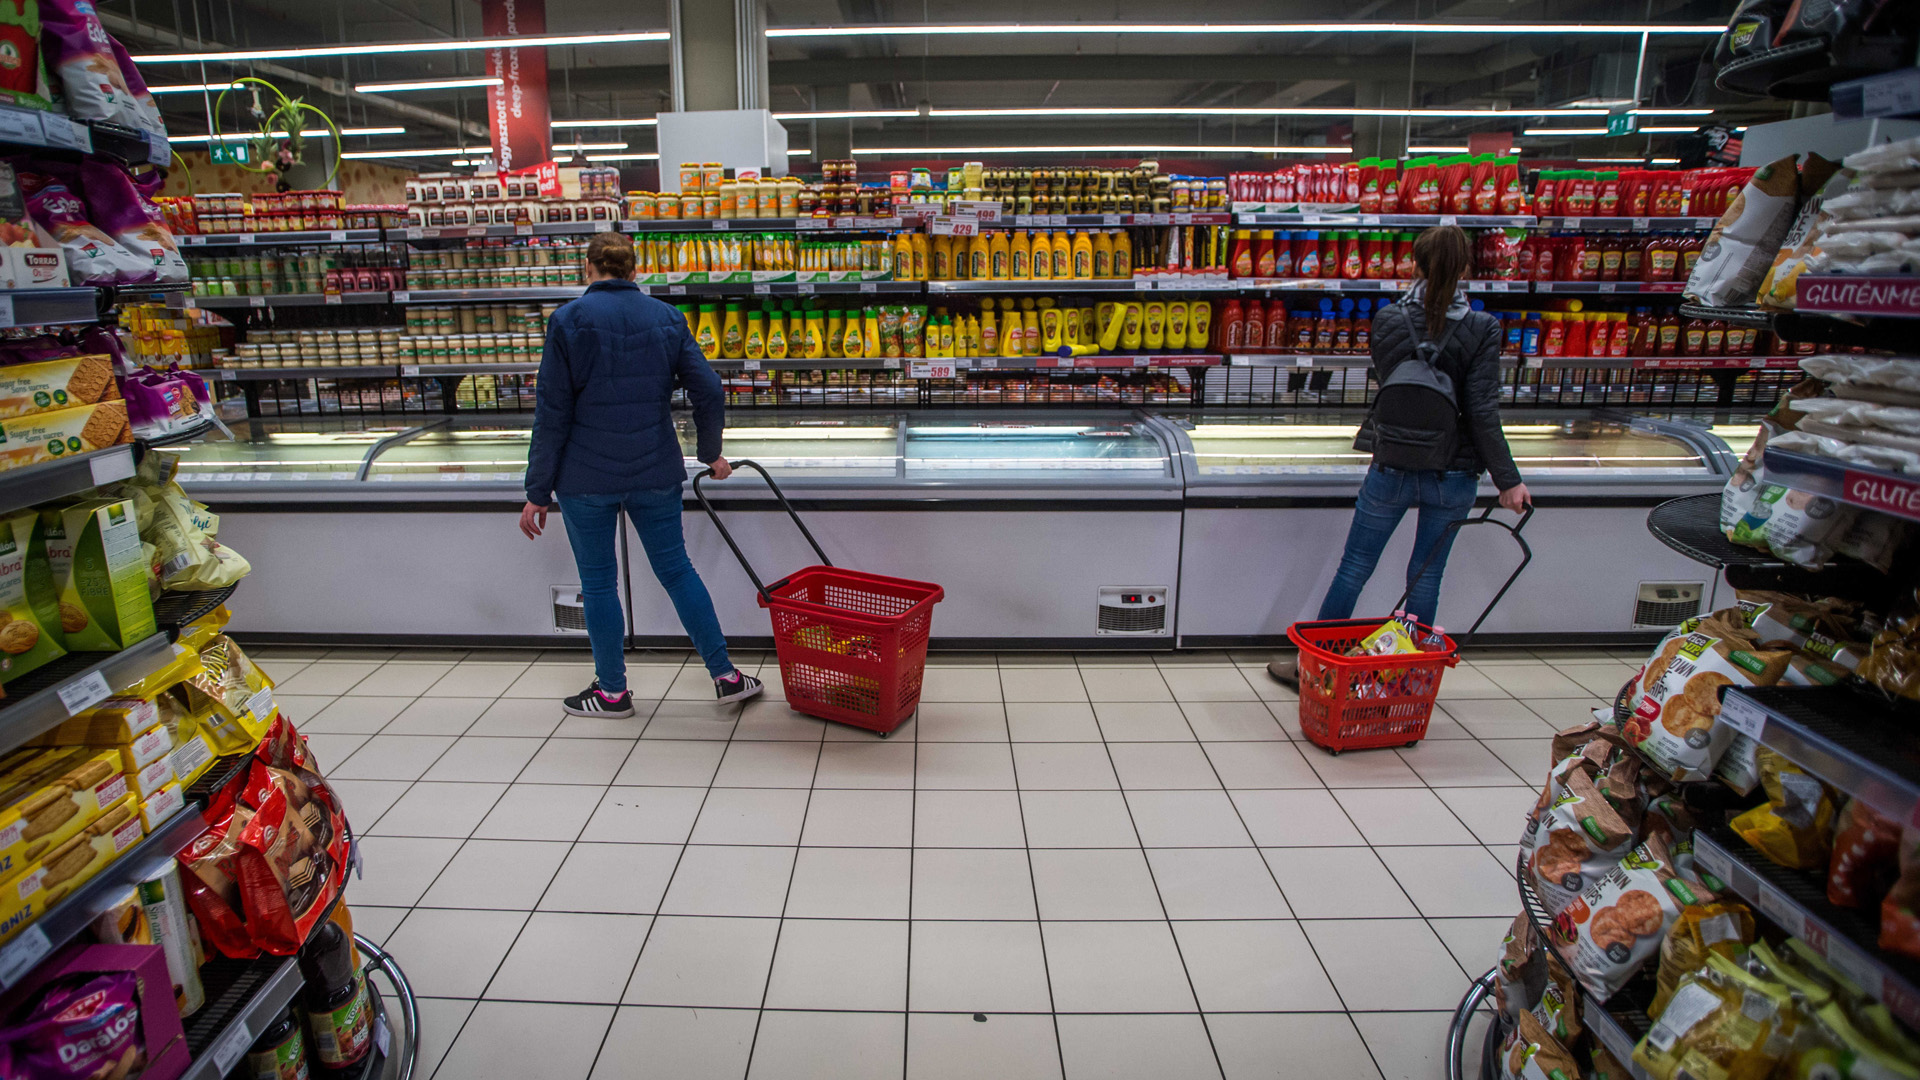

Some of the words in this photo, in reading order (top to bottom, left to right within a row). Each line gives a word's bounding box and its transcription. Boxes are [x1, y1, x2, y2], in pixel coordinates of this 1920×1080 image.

[508, 44, 522, 118] deep-froze
[953, 224, 972, 235] 429
[931, 367, 950, 377] 589
[31, 426, 46, 435] free
[1689, 632, 1707, 646] rice
[1749, 658, 1765, 671] FREE
